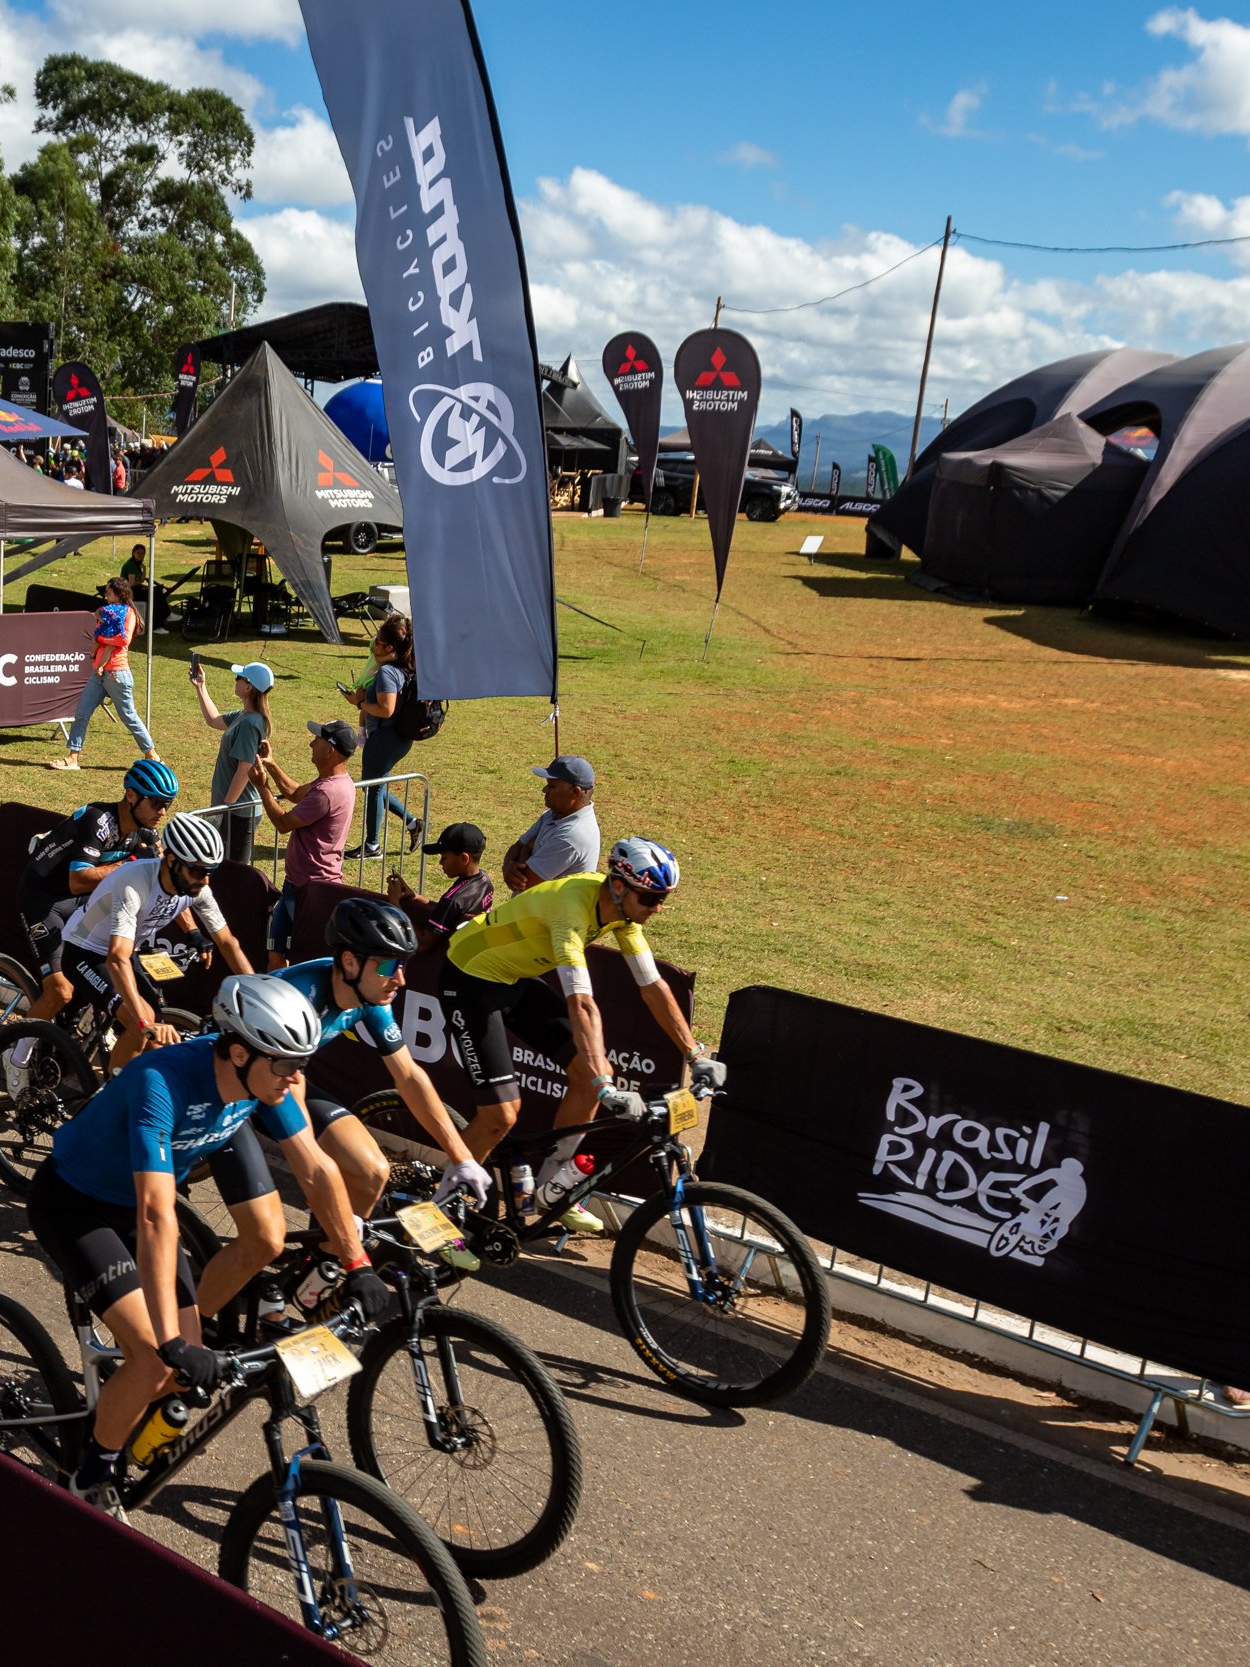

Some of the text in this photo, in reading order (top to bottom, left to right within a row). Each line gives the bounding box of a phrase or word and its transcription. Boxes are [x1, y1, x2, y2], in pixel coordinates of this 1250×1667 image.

[171, 484, 241, 497] MITSUBISHI
[315, 488, 374, 500] MITSUBISHI
[176, 493, 228, 504] MOTORS
[328, 498, 373, 509] MOTORS
[24, 652, 85, 662] CONFEDERAÇÃO
[24, 664, 79, 674] BRASILEIRA DE
[24, 675, 60, 685] CICLISMO
[76, 960, 109, 995] LA MAGLIA
[461, 1030, 485, 1086] VOUZELA
[886, 1077, 1050, 1169] Brasil
[872, 1133, 1029, 1219] RIDE
